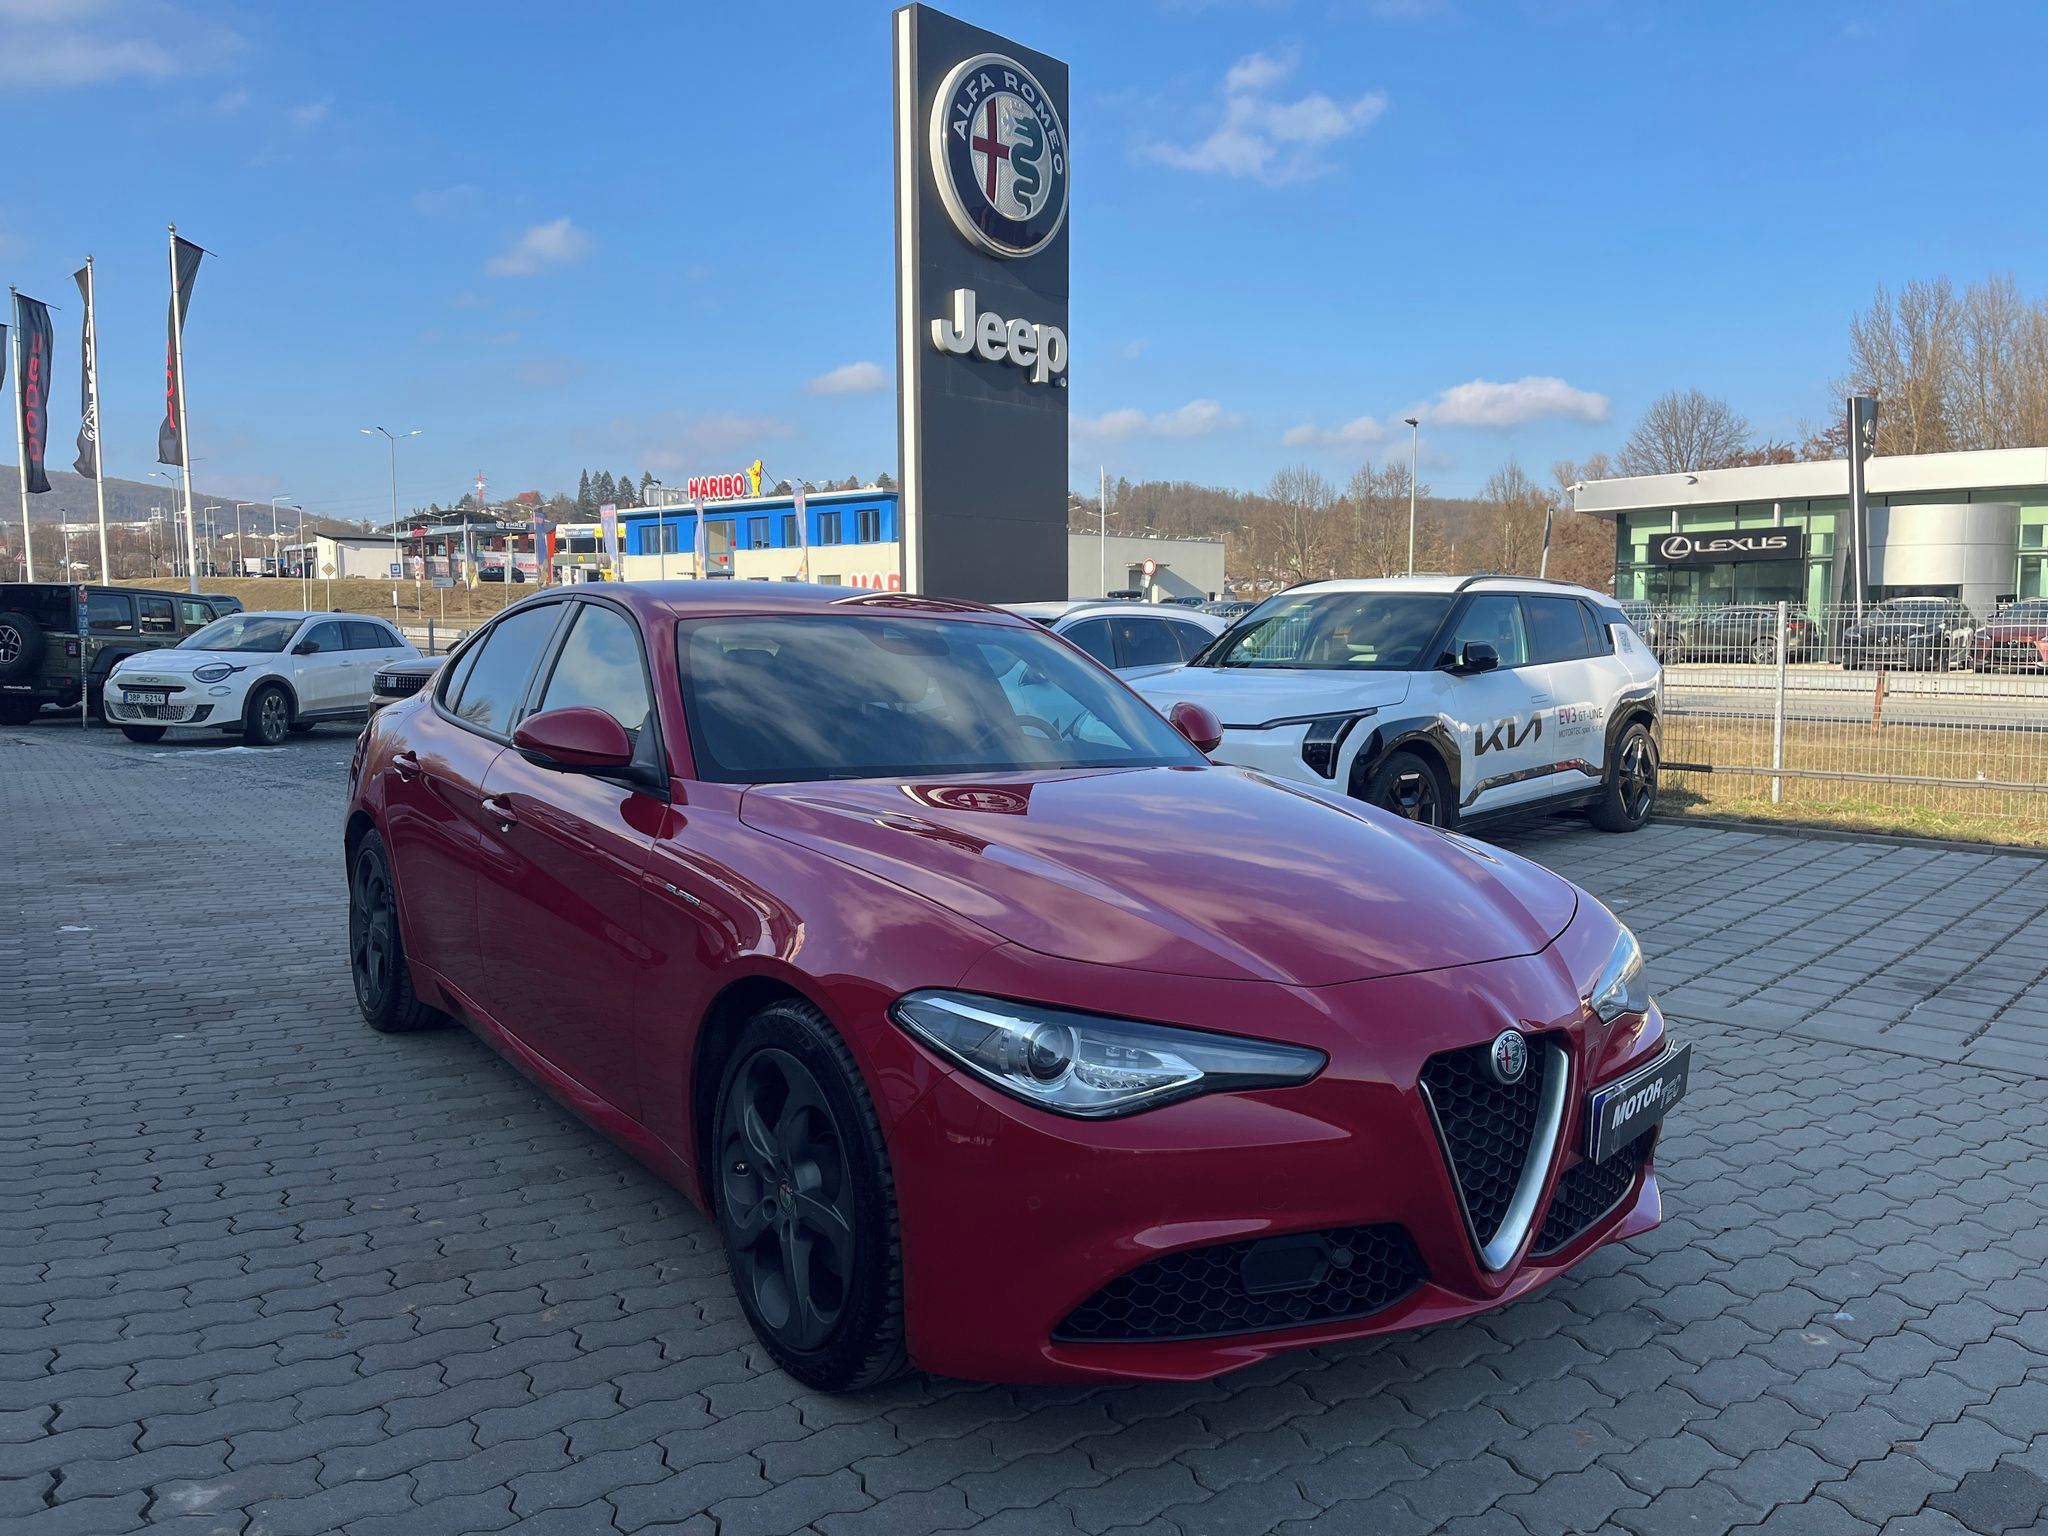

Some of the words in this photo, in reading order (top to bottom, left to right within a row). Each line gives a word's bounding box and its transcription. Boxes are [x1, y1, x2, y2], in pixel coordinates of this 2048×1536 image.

[953, 72, 996, 141] ALFA
[1003, 71, 1064, 175] ROMEO
[931, 288, 1068, 383] Jeep
[689, 474, 744, 500] HARIBO
[1694, 535, 1788, 553] LEXUS
[144, 694, 162, 703] 5214
[1559, 706, 1577, 725] EV3
[1579, 707, 1603, 722] GT-LINE
[1475, 711, 1542, 756] KIA
